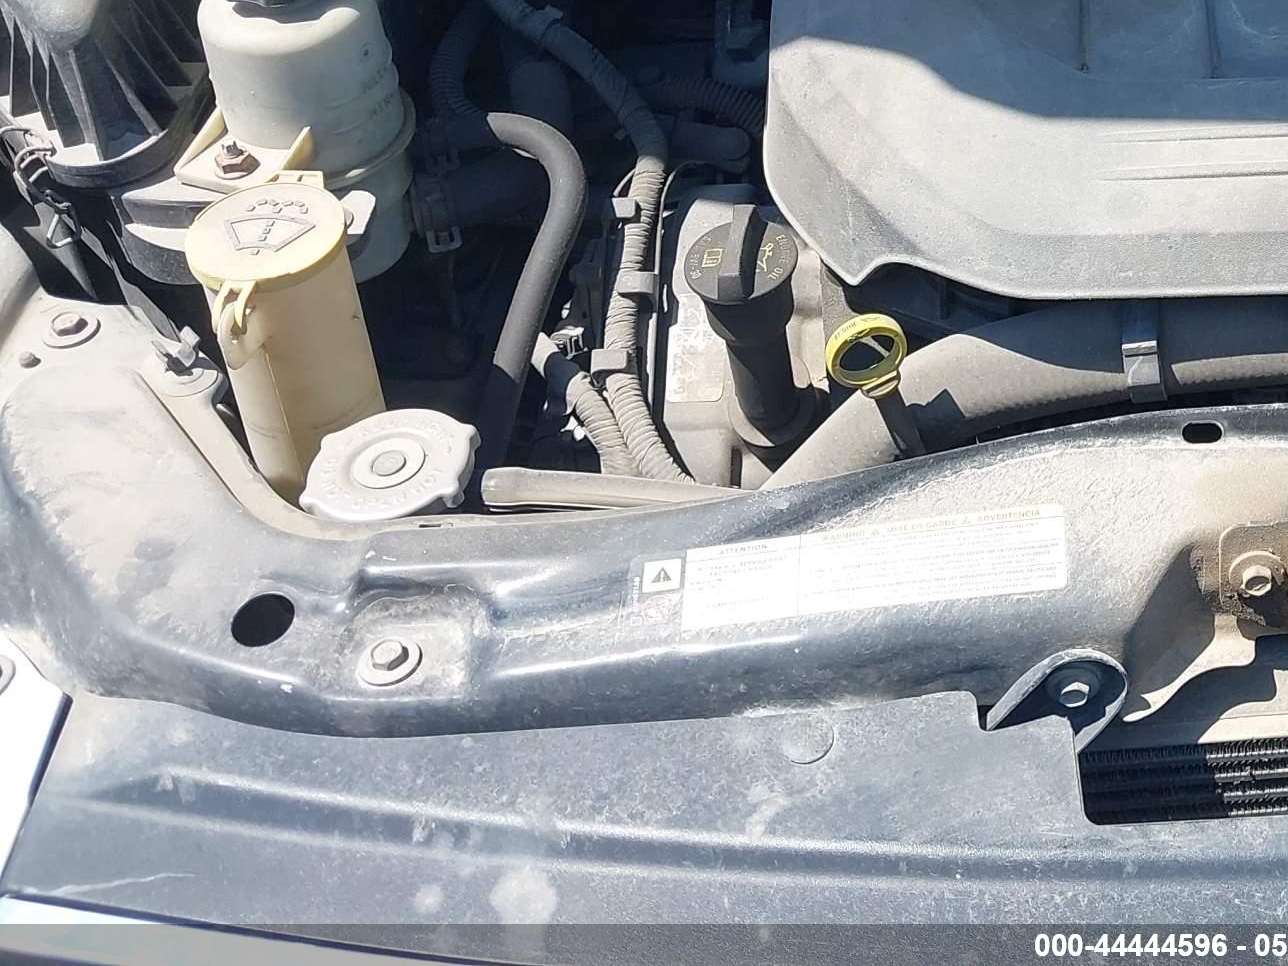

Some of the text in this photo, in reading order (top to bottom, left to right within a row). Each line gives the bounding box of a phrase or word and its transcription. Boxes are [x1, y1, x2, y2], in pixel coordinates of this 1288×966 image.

[767, 266, 784, 281] OIL
[821, 528, 866, 541] WARNING
[926, 518, 957, 529] GARDE
[977, 508, 1041, 523] ADVERTENCIA
[720, 543, 768, 555] ATTENTION
